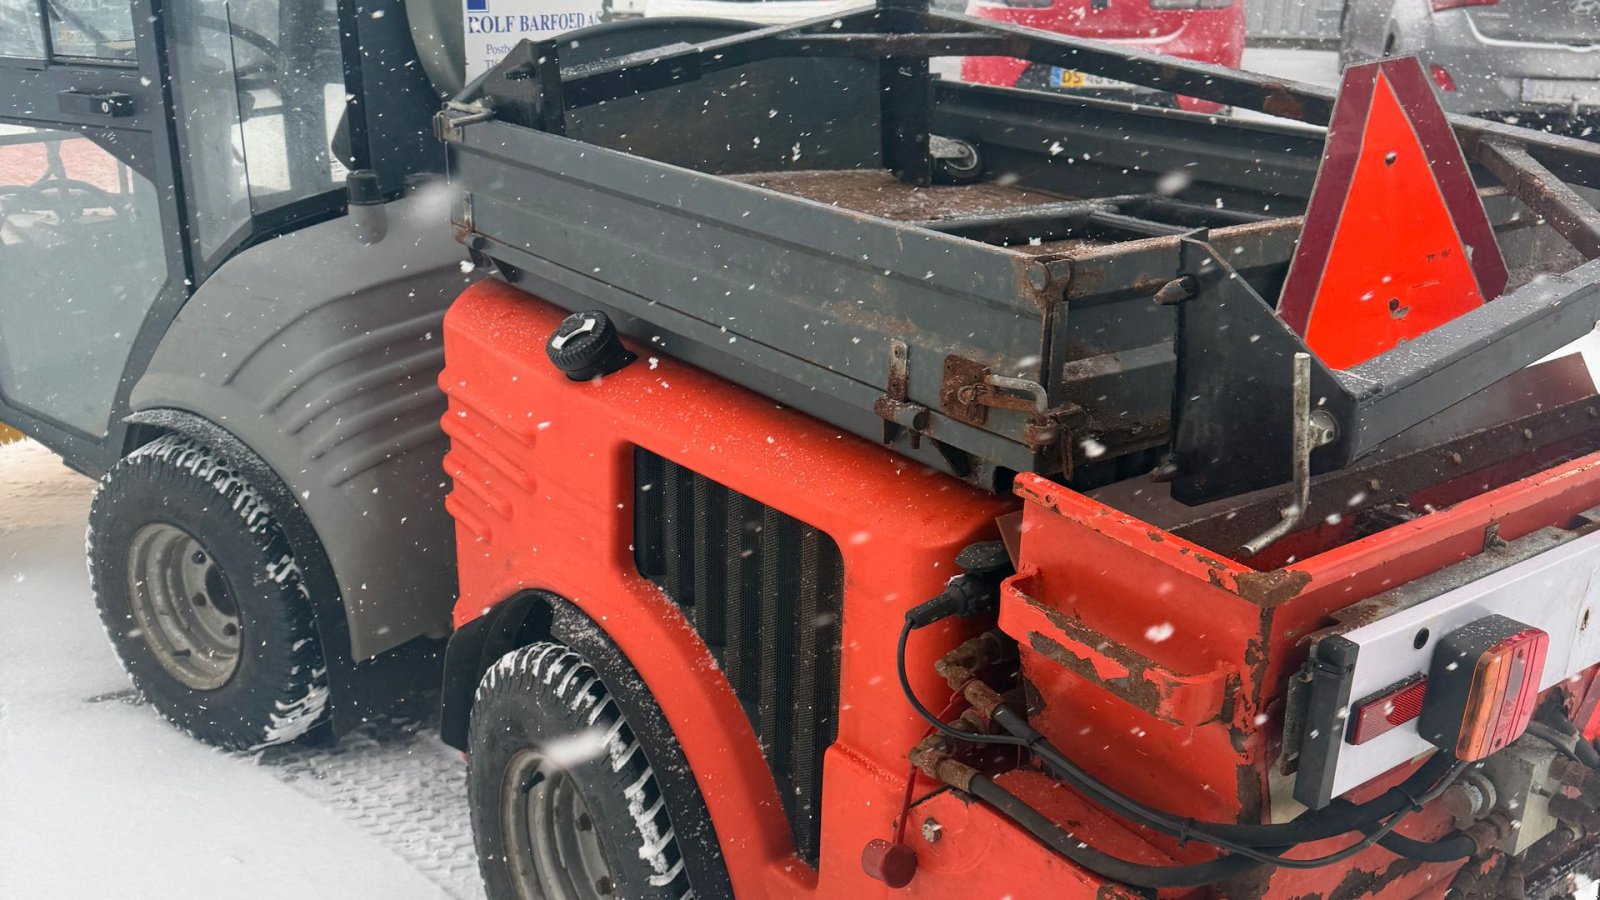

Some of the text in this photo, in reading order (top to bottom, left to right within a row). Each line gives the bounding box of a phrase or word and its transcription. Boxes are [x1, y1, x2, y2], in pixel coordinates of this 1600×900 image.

[468, 16, 514, 33] ROLF
[520, 13, 585, 32] BARFOED
[486, 44, 513, 55] Postb
[1063, 70, 1083, 84] DS
